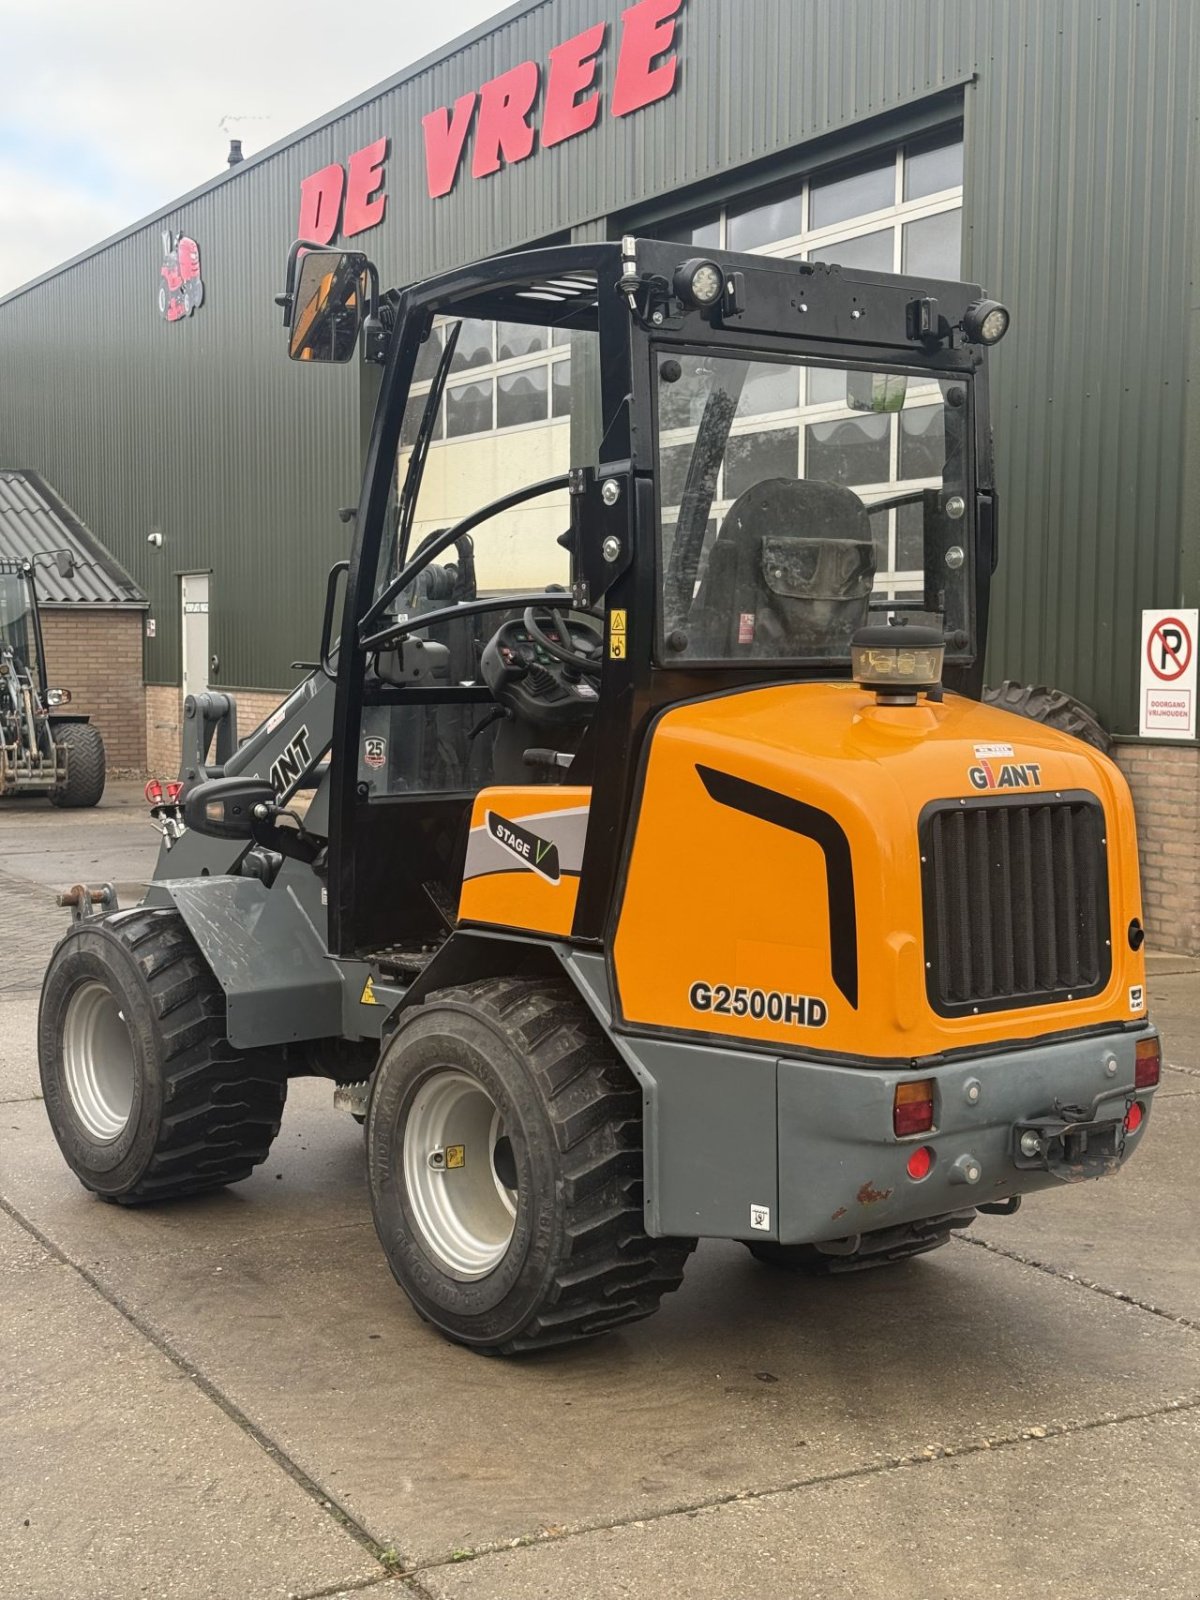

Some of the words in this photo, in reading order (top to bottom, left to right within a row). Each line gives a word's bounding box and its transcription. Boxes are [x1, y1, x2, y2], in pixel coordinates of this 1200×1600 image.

[297, 136, 387, 254] DE
[422, 0, 682, 199] VREE
[1161, 629, 1182, 669] P
[260, 724, 312, 800] ANT
[367, 741, 382, 757] 25
[496, 824, 531, 858] STAGE
[689, 981, 828, 1028] G2500HD
